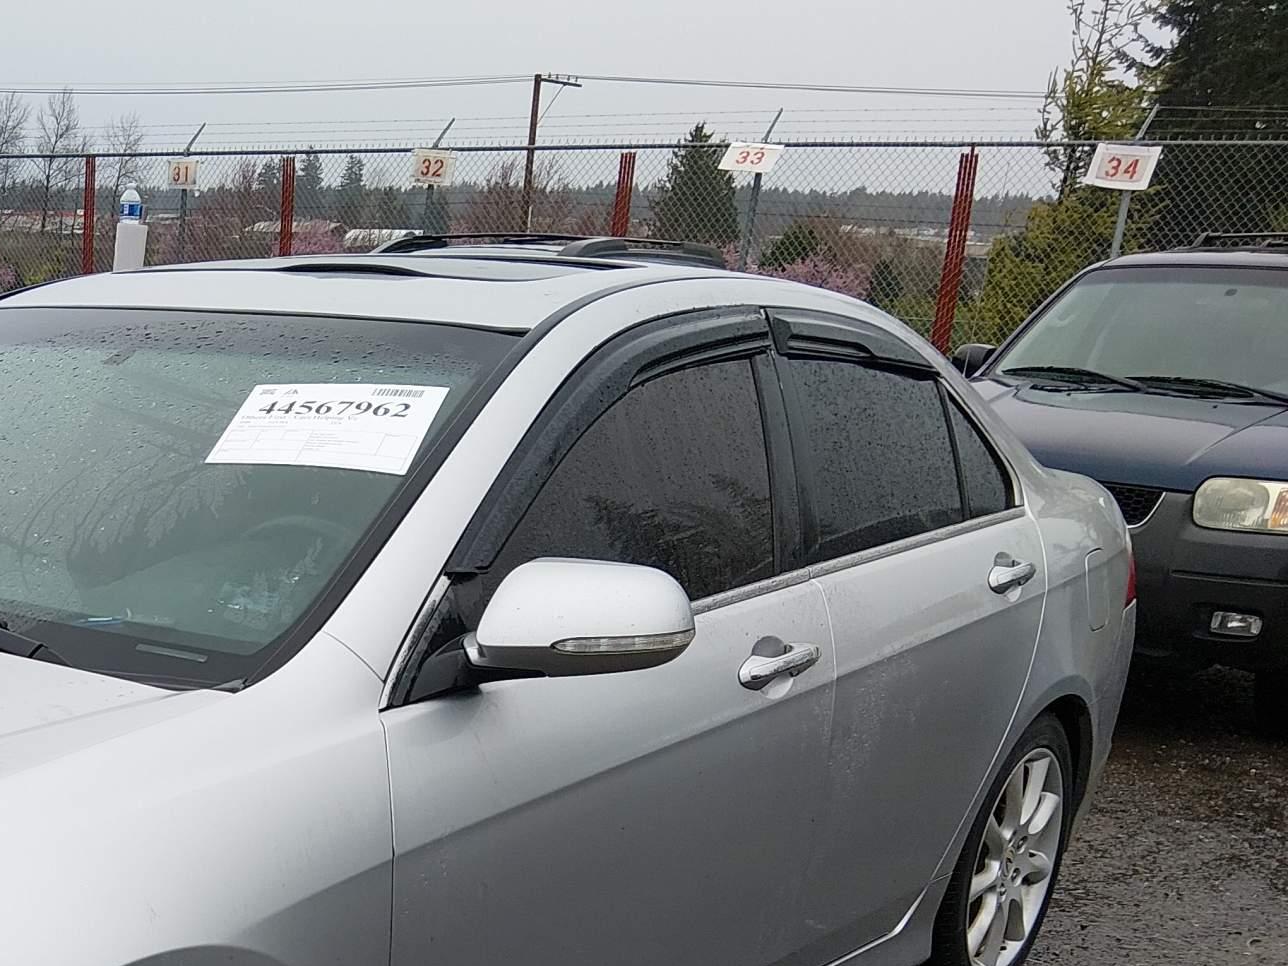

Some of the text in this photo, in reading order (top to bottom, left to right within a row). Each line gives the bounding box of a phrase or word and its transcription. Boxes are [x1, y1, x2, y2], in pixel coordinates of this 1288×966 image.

[735, 149, 766, 166] 33
[172, 165, 189, 182] 31
[420, 157, 445, 178] 32
[1105, 156, 1141, 180] 34
[259, 400, 411, 418] 44567962
